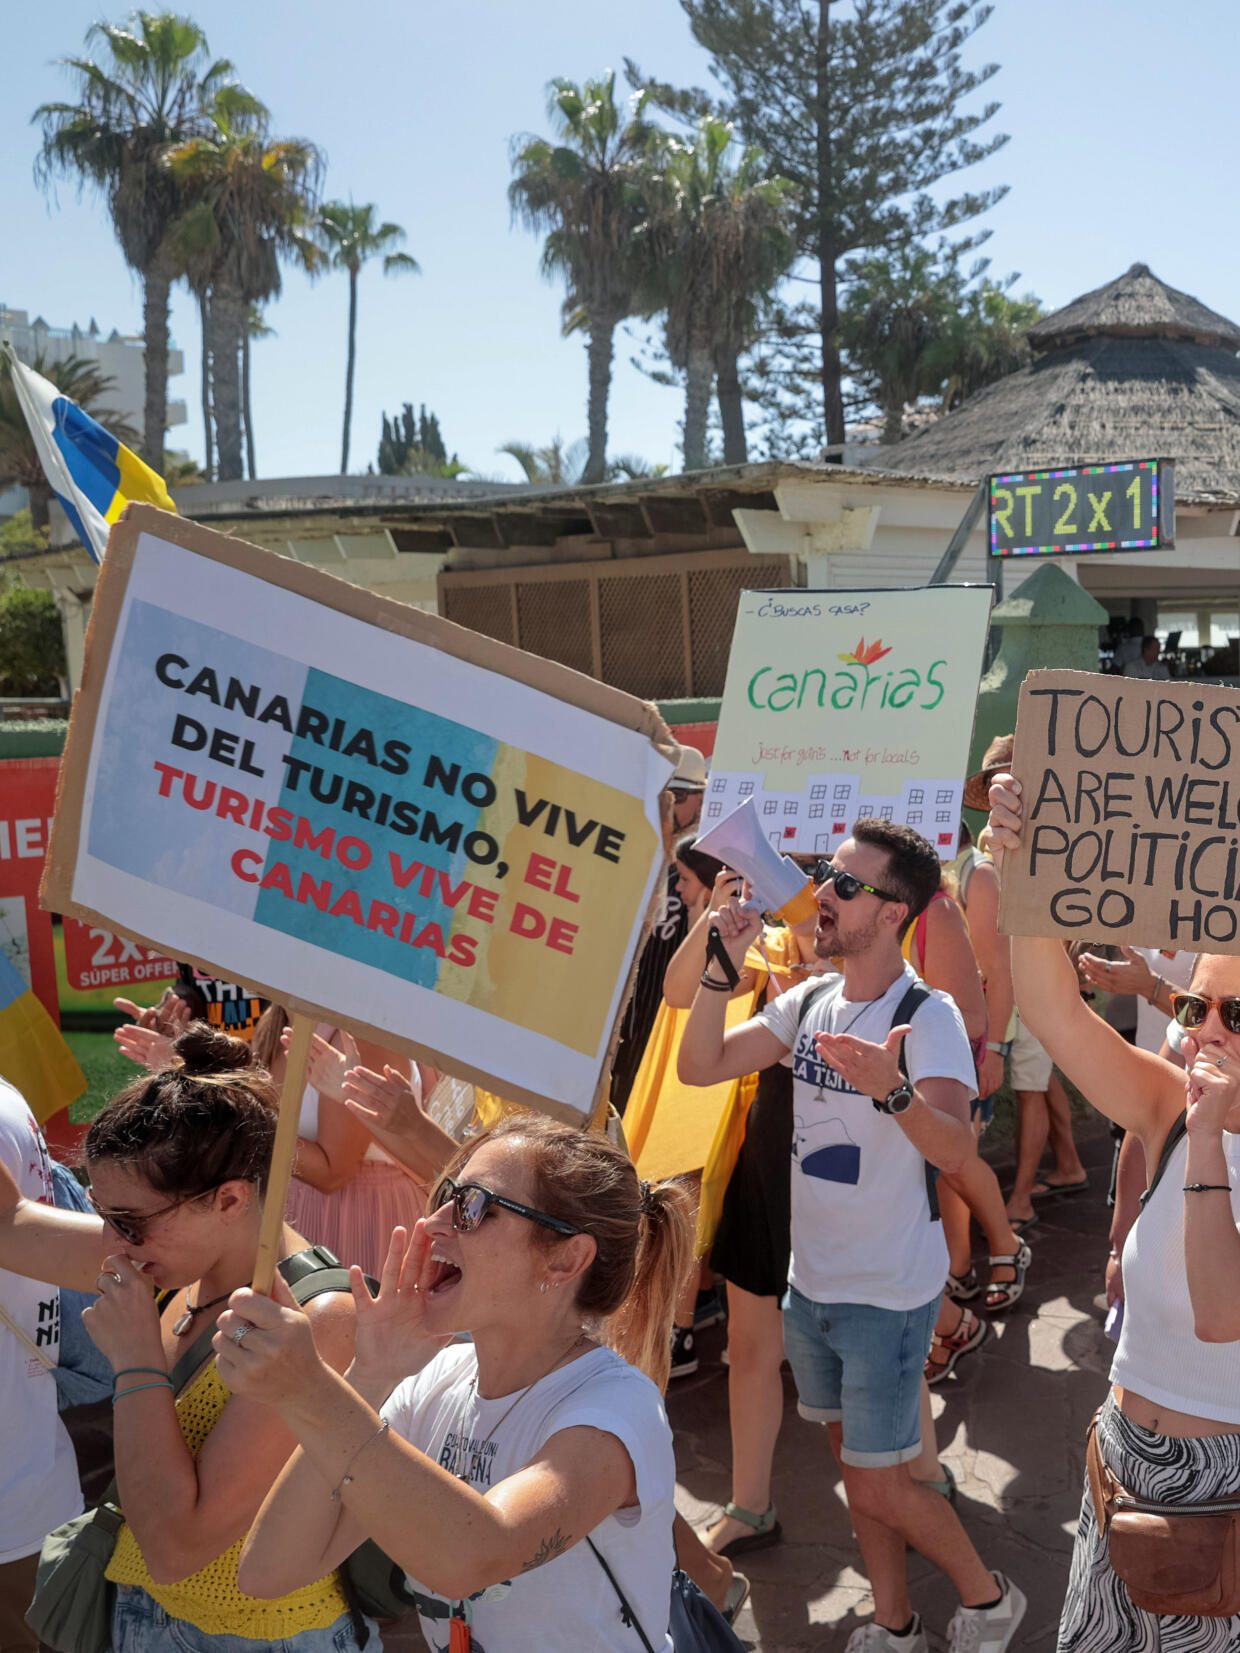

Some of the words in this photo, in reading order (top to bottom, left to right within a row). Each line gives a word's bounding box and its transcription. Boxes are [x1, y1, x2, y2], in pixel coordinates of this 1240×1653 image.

[828, 602, 871, 616] CASA?
[155, 653, 412, 776] CANARIAS
[423, 755, 497, 808] NO
[514, 789, 627, 865] VIVE
[170, 713, 265, 778] DEL
[282, 754, 510, 879] TURISMO,
[523, 852, 582, 903] EL
[1031, 769, 1135, 825] ARE
[153, 761, 372, 871] TURISMO
[388, 851, 500, 924] VIVE
[508, 903, 581, 956] DE
[230, 848, 479, 968] CANARIAS
[1050, 887, 1135, 928] GO
